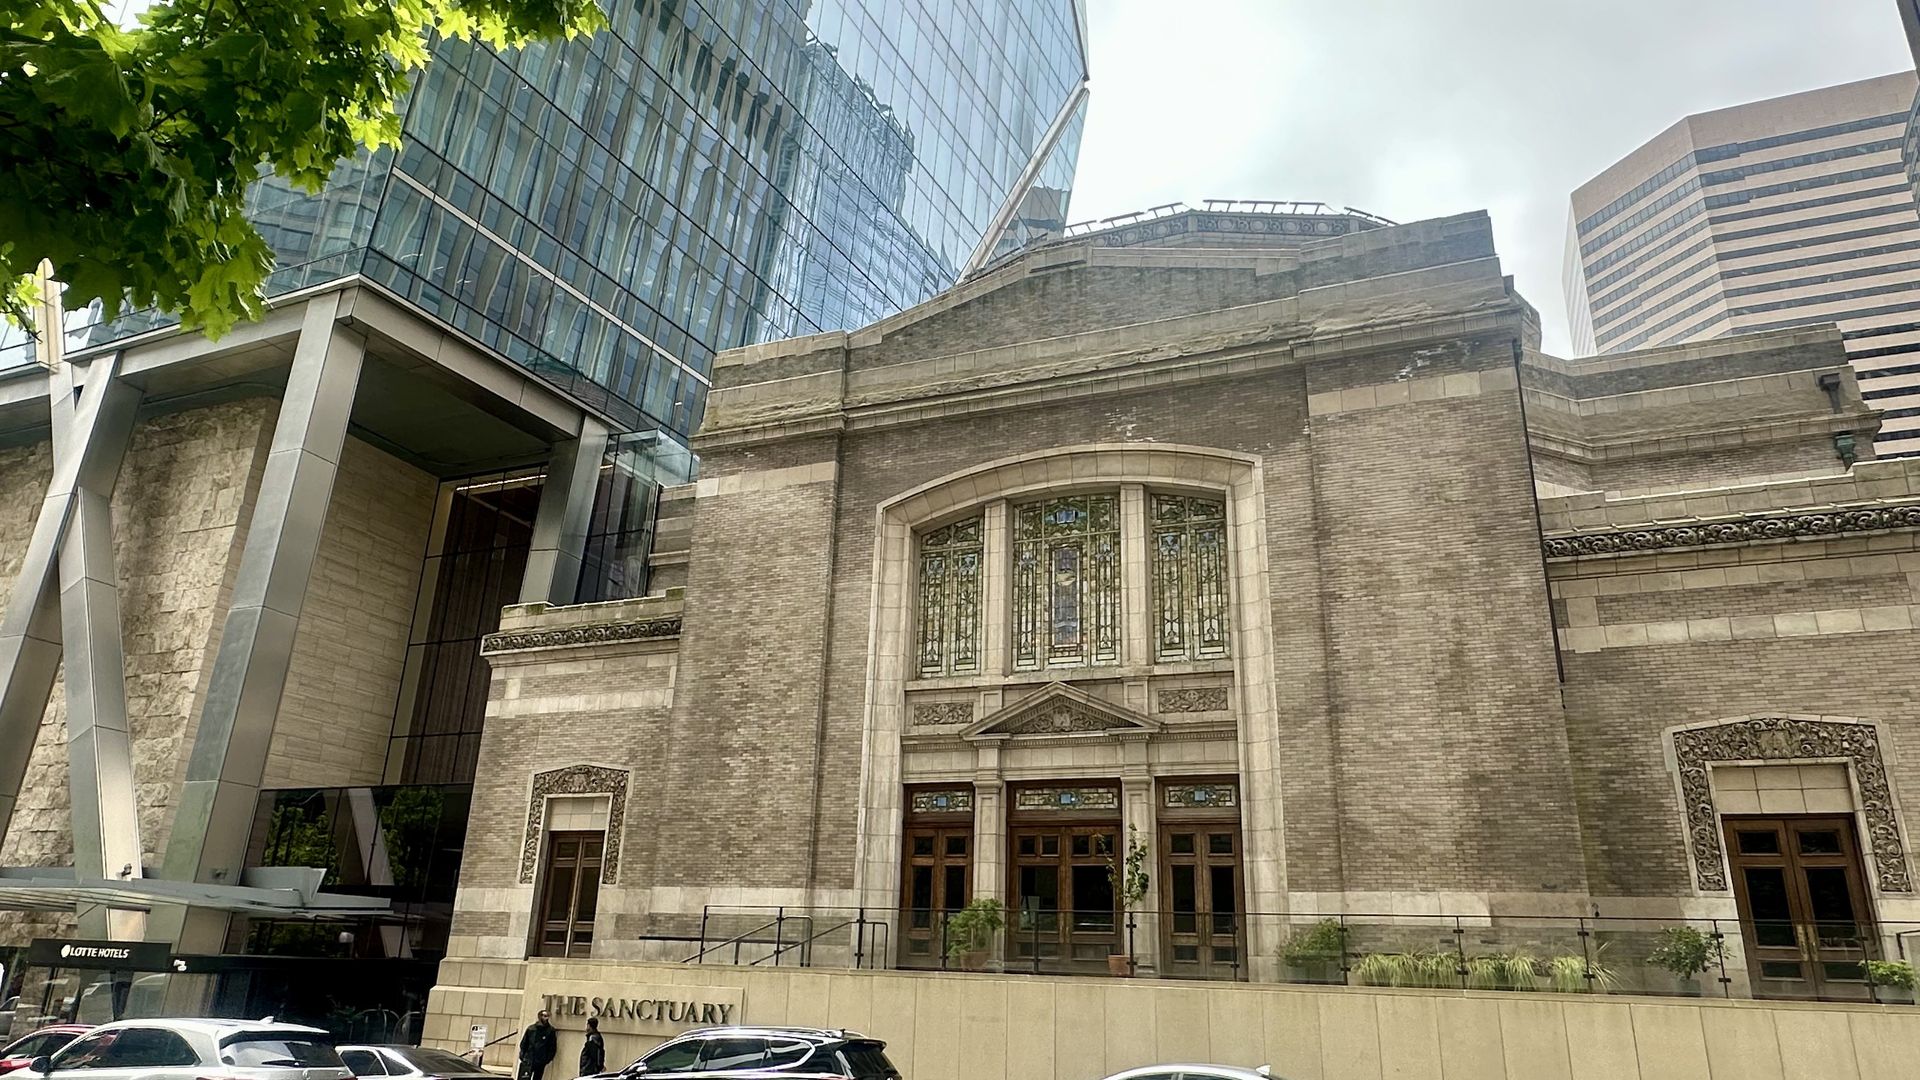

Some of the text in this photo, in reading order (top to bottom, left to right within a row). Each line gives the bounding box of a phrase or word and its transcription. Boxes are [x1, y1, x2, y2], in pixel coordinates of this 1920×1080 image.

[70, 947, 130, 958] LOTTE HOTELS
[542, 994, 734, 1025] THE SANCTUARY
